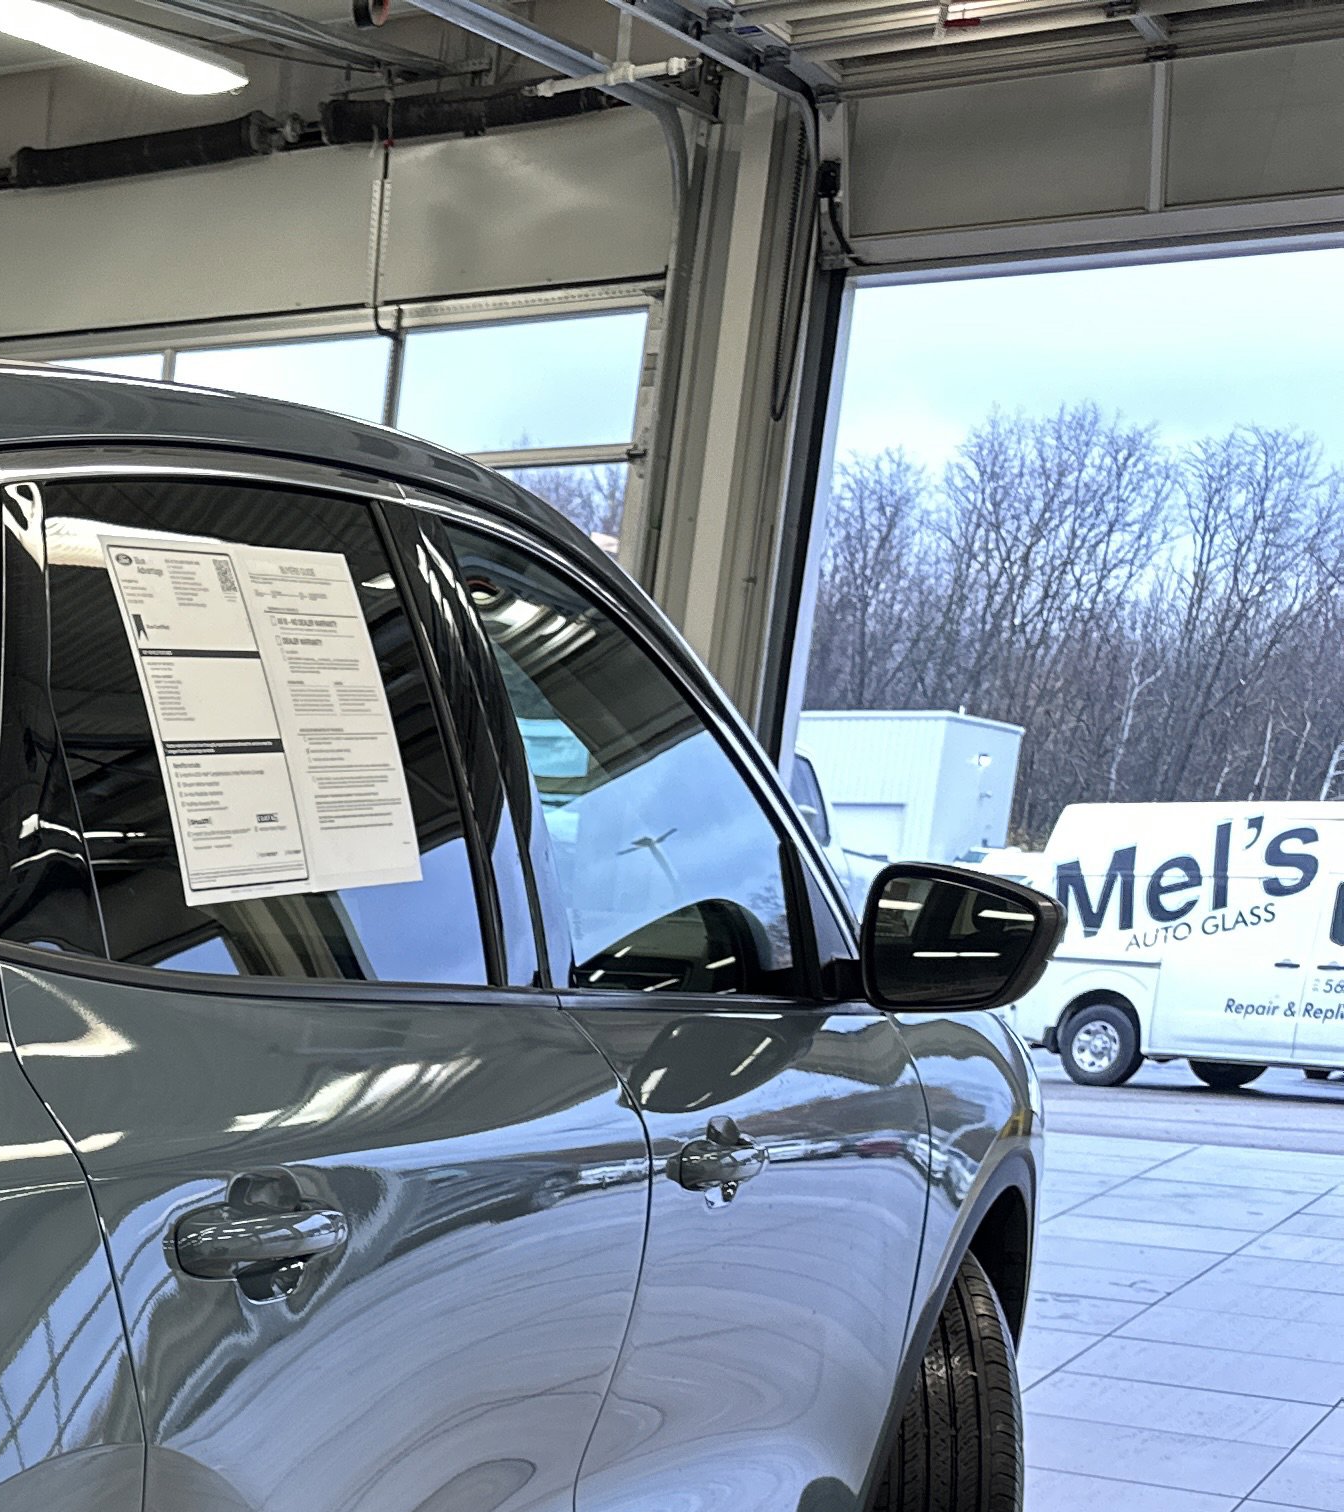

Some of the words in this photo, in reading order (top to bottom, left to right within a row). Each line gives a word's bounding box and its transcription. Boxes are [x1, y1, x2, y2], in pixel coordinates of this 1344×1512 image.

[1057, 814, 1319, 938] Mel's
[1125, 921, 1192, 951] AUTO
[1201, 902, 1276, 936] GLASS
[1224, 998, 1280, 1021] Repair
[1283, 1001, 1296, 1019] &
